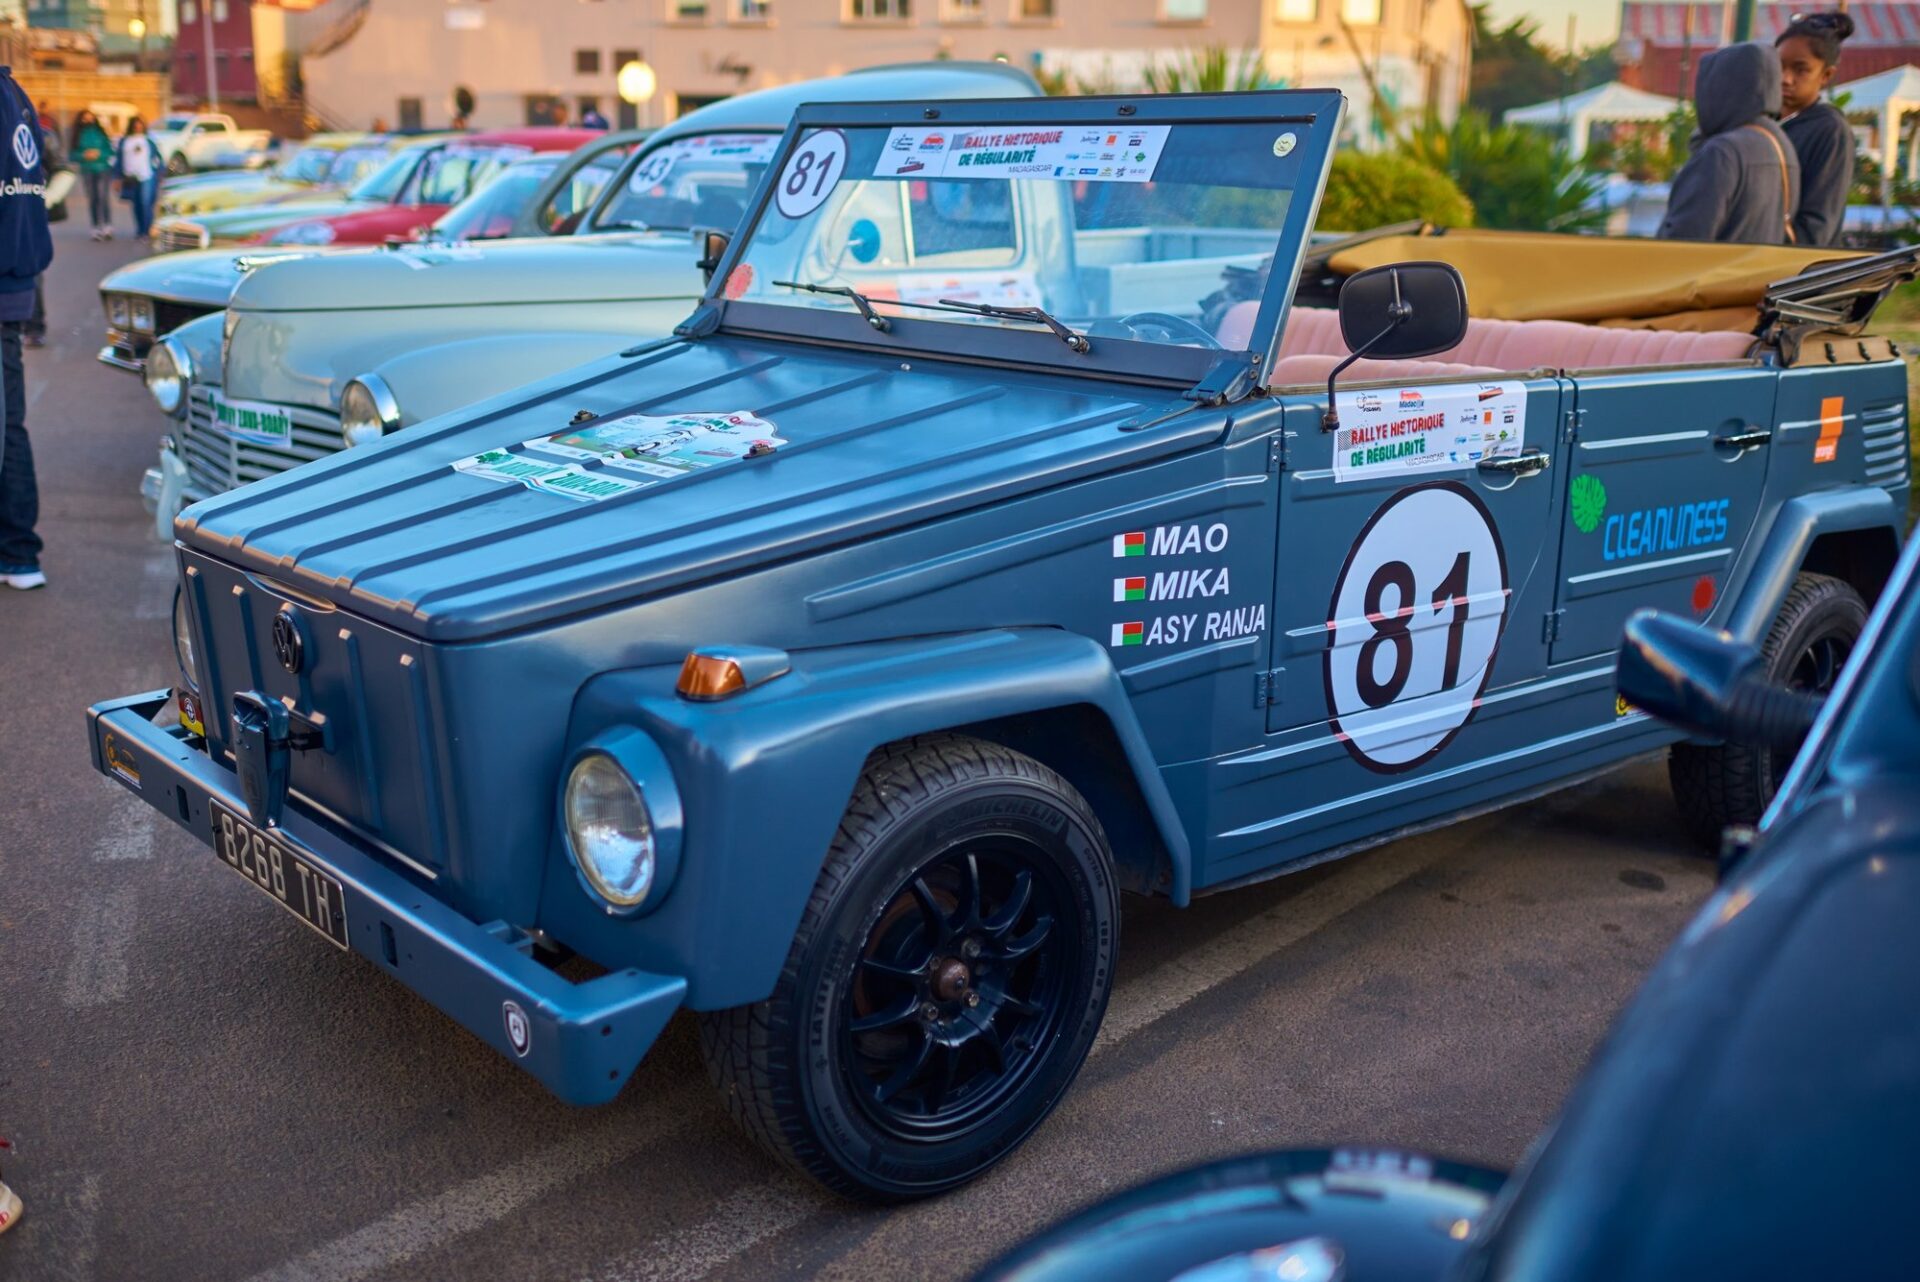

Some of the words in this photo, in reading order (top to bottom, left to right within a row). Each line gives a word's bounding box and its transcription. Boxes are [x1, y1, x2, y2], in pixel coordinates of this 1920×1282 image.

[958, 153, 973, 166] DE
[973, 146, 1036, 165] RÉGULARITÉ
[964, 135, 1002, 148] RALLYE
[1003, 131, 1063, 146] HISTORIQUE
[639, 158, 669, 182] 43
[786, 151, 836, 196] 81
[1351, 424, 1388, 445] RALLYE
[1390, 413, 1445, 438] HISTORIQUE
[1351, 451, 1364, 467] DE
[1366, 433, 1426, 464] RÉGULARITÉ
[1150, 523, 1229, 556] MAO
[1603, 498, 1730, 560] CLEANLINESS
[1149, 567, 1230, 601] MIKA
[1145, 614, 1198, 646] ASY
[1203, 604, 1266, 641] RANJA
[1356, 551, 1472, 709] 81
[221, 813, 286, 901] 8268
[295, 862, 333, 935] TH
